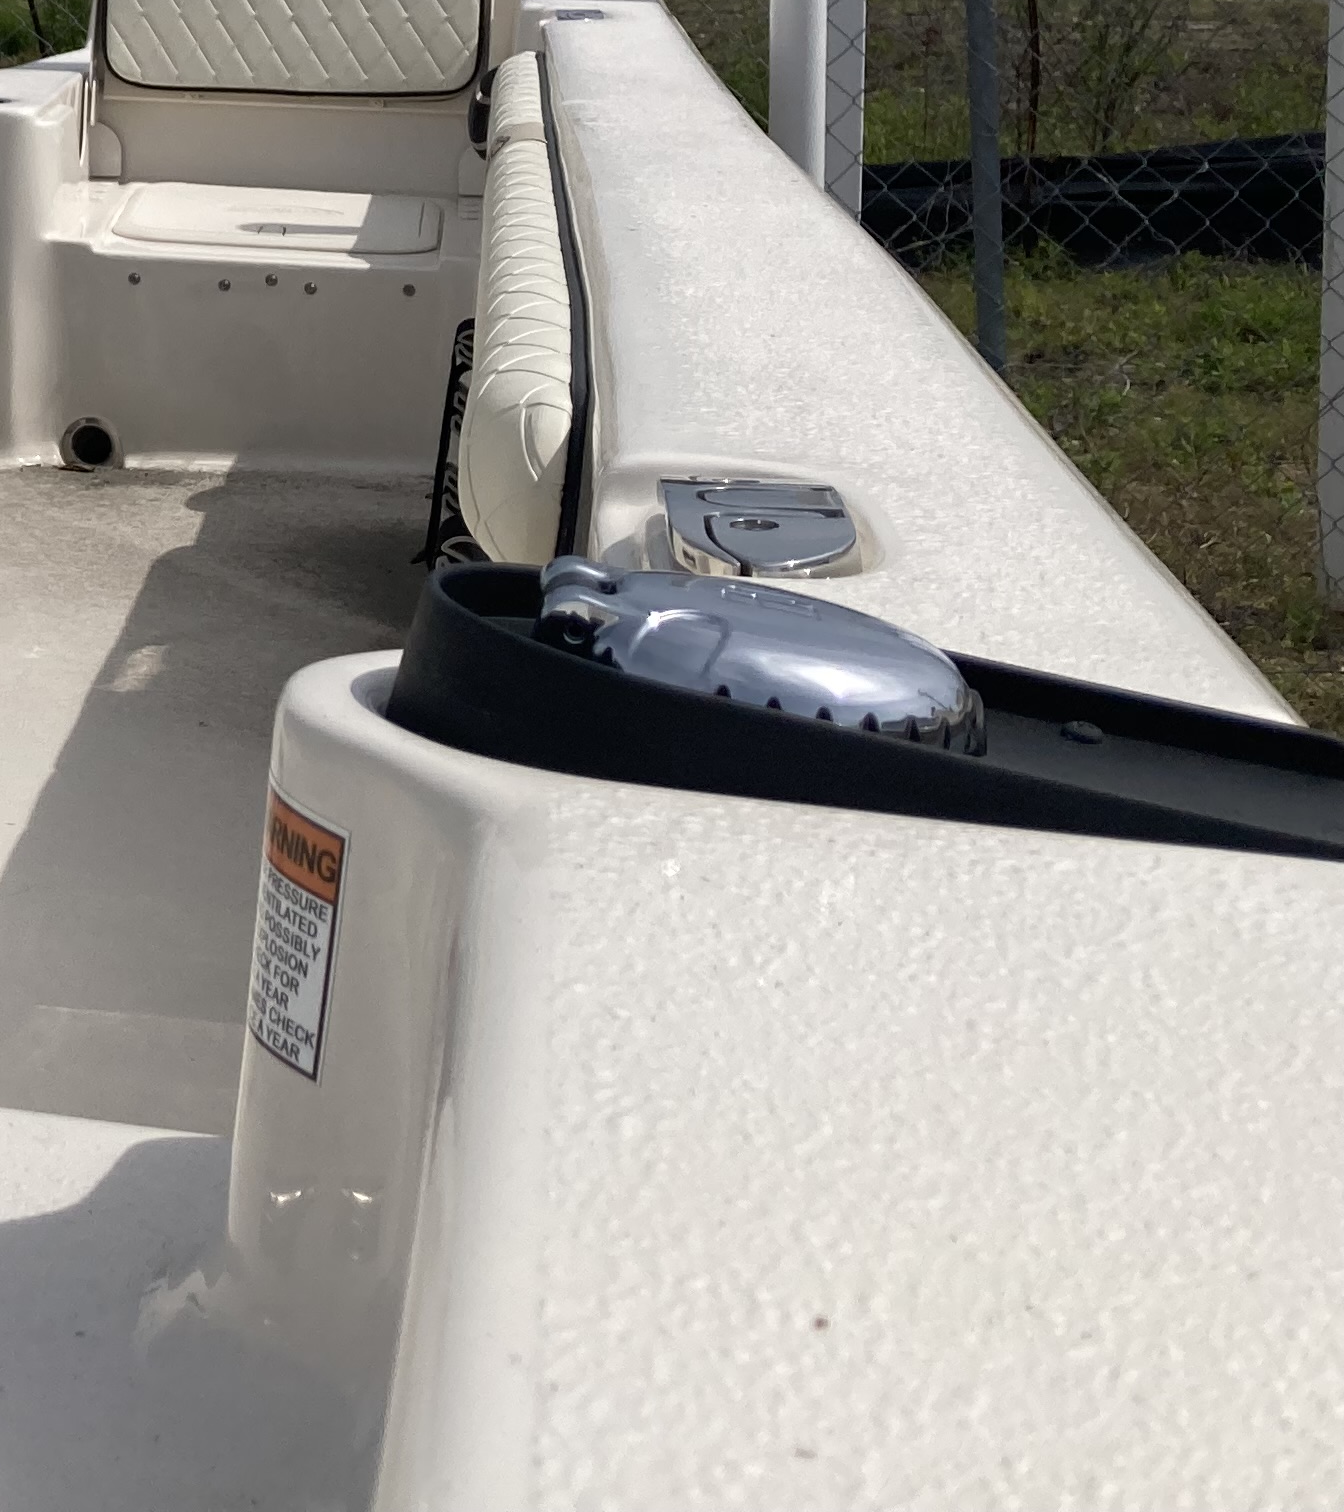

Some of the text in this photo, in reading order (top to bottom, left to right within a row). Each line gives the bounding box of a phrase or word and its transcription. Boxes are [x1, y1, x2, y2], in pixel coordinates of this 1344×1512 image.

[262, 976, 289, 1011] YEAR
[273, 965, 299, 997] FOR
[267, 1024, 300, 1063] YEAR
[269, 1006, 314, 1050] CHECK
